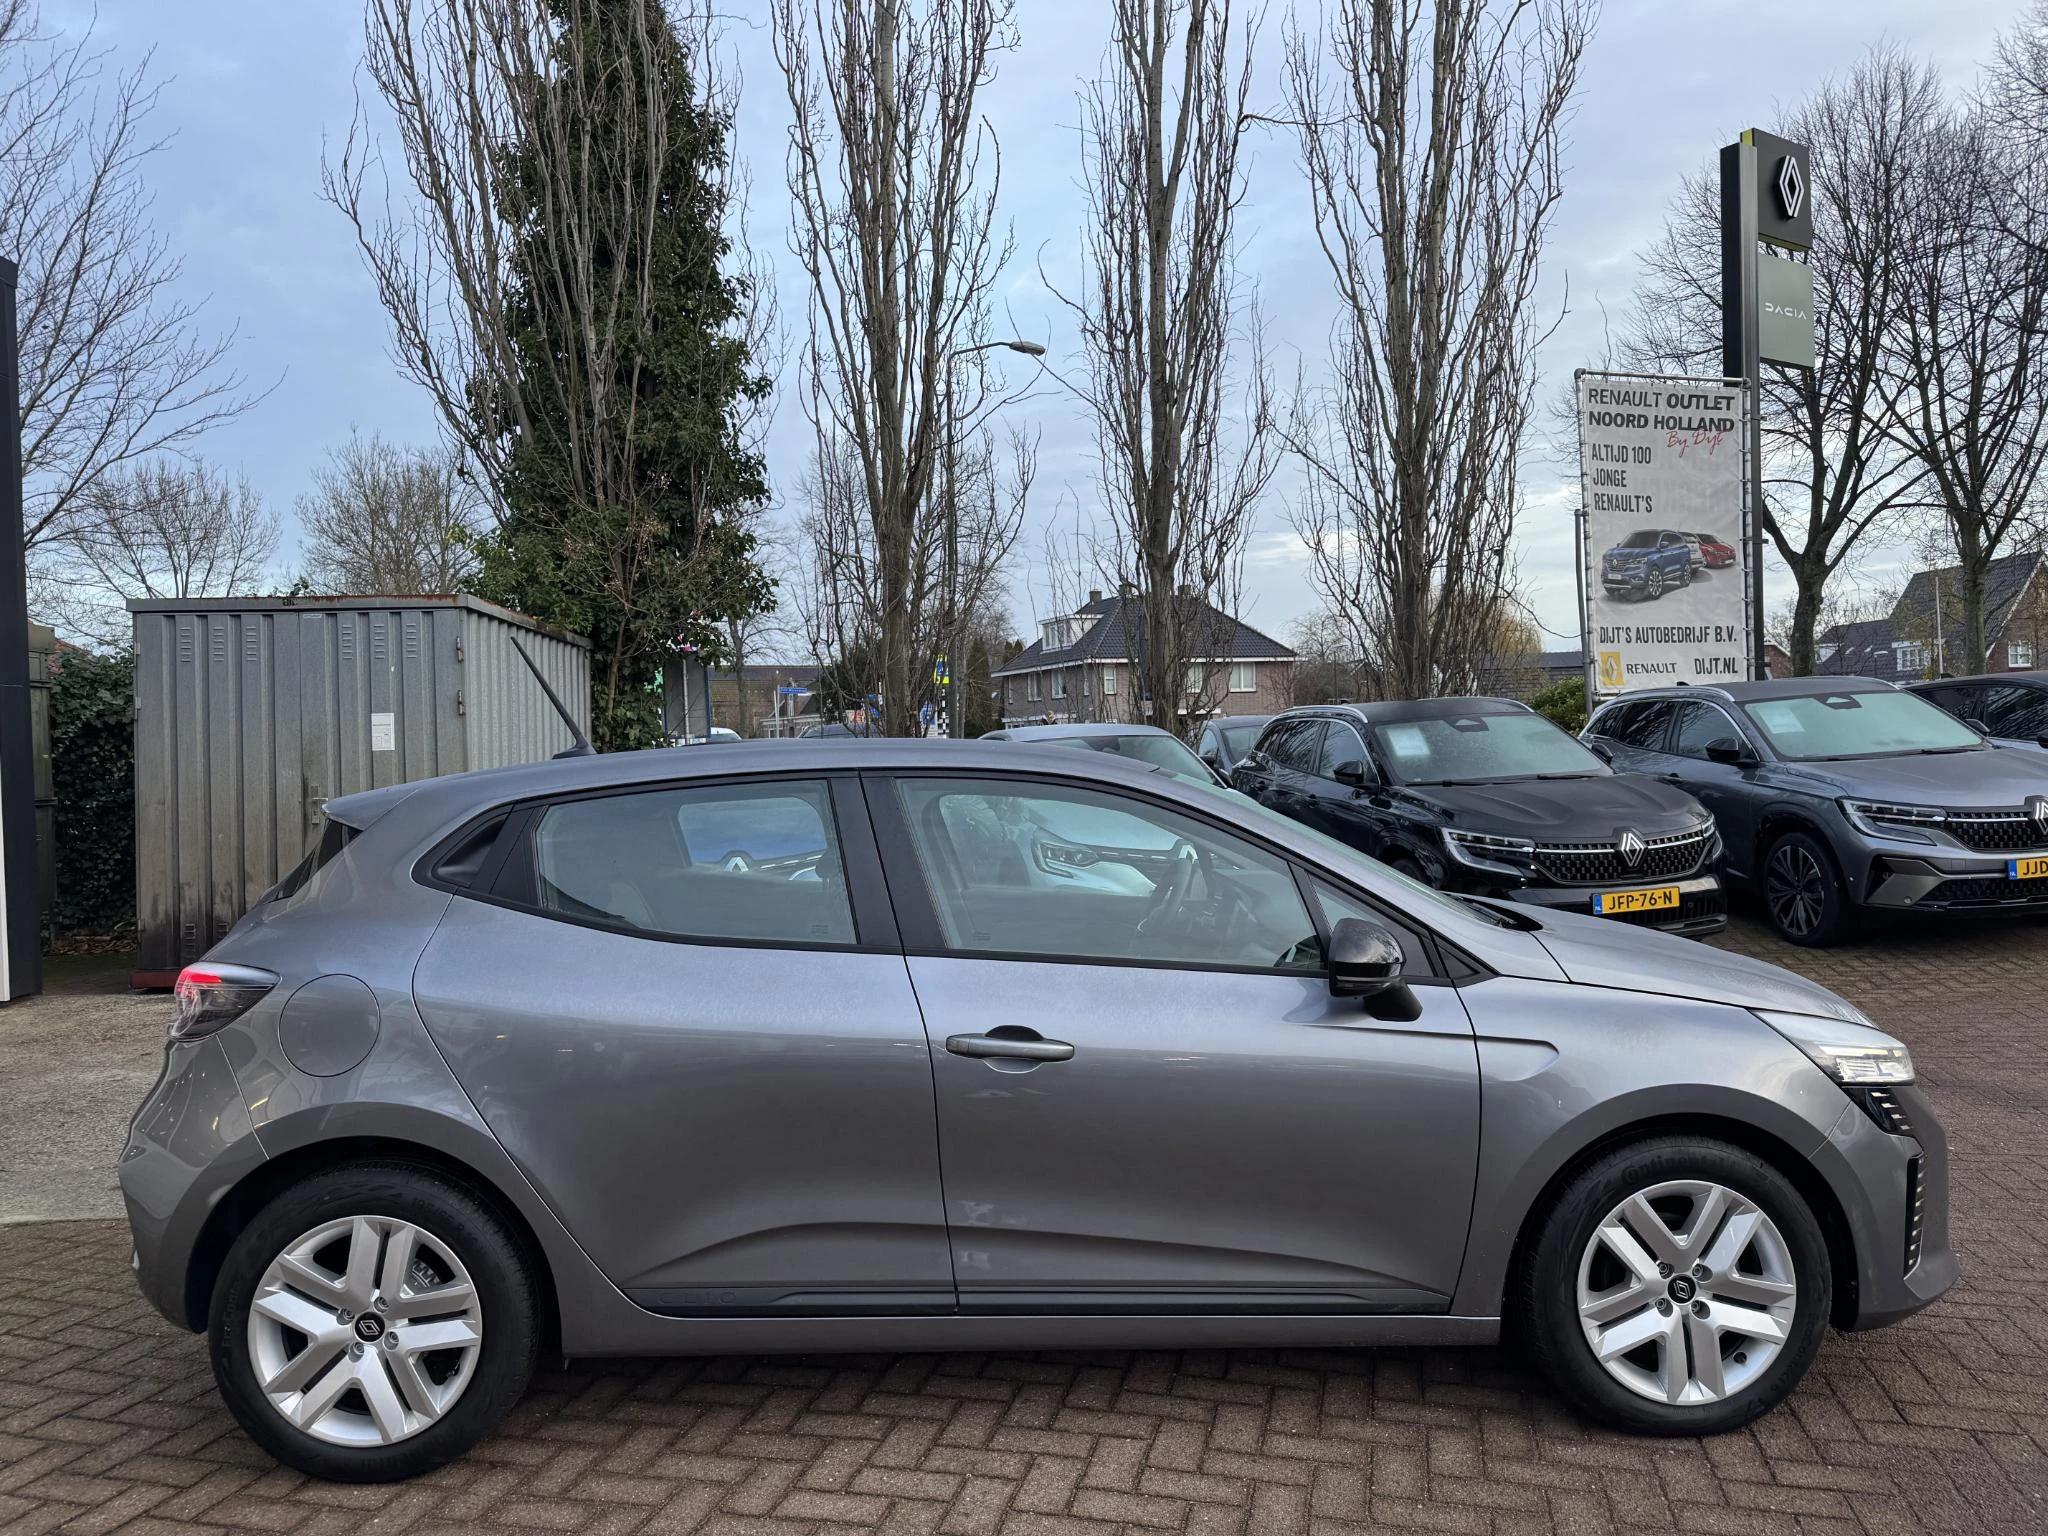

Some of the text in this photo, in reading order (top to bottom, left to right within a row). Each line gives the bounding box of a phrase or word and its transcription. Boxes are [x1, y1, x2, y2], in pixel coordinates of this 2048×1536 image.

[1765, 302, 1807, 320] DACIA
[1588, 388, 1735, 411] RENAULT OUTLET
[1588, 411, 1735, 432] NOORD HOLLAND
[1591, 443, 1652, 464] ALTIJD 100
[1666, 430, 1689, 458] By
[1593, 468, 1627, 487] JONGE
[1594, 492, 1653, 513] RENAULT'S
[1600, 625, 1737, 643] DIJT'S AUTOBEDRIJF B.V.
[1626, 657, 1738, 675] RENAULT DIJT.NL
[1608, 890, 1673, 910] JFP-76-N
